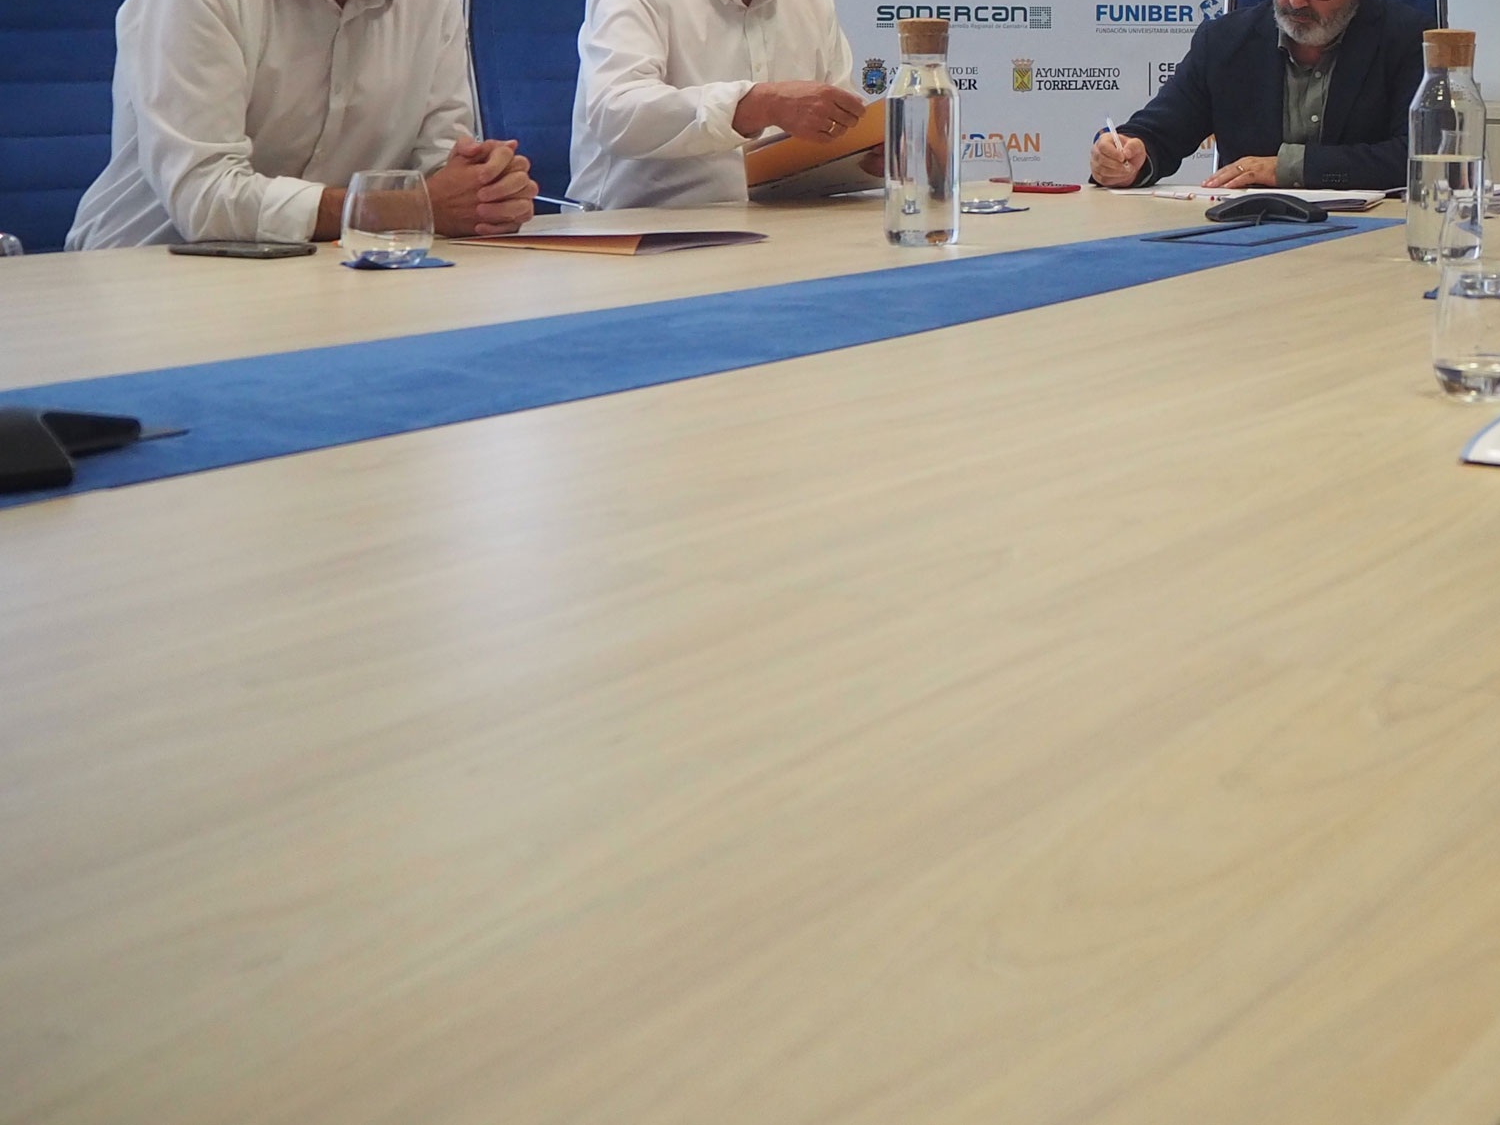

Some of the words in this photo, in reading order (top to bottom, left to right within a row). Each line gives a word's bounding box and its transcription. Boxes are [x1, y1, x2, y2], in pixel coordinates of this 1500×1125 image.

[1095, 4, 1193, 22] FUNIBER
[966, 66, 979, 75] DE
[1035, 67, 1120, 78] AYUNTAMIENTO
[1036, 79, 1120, 91] TORRELAVEGA
